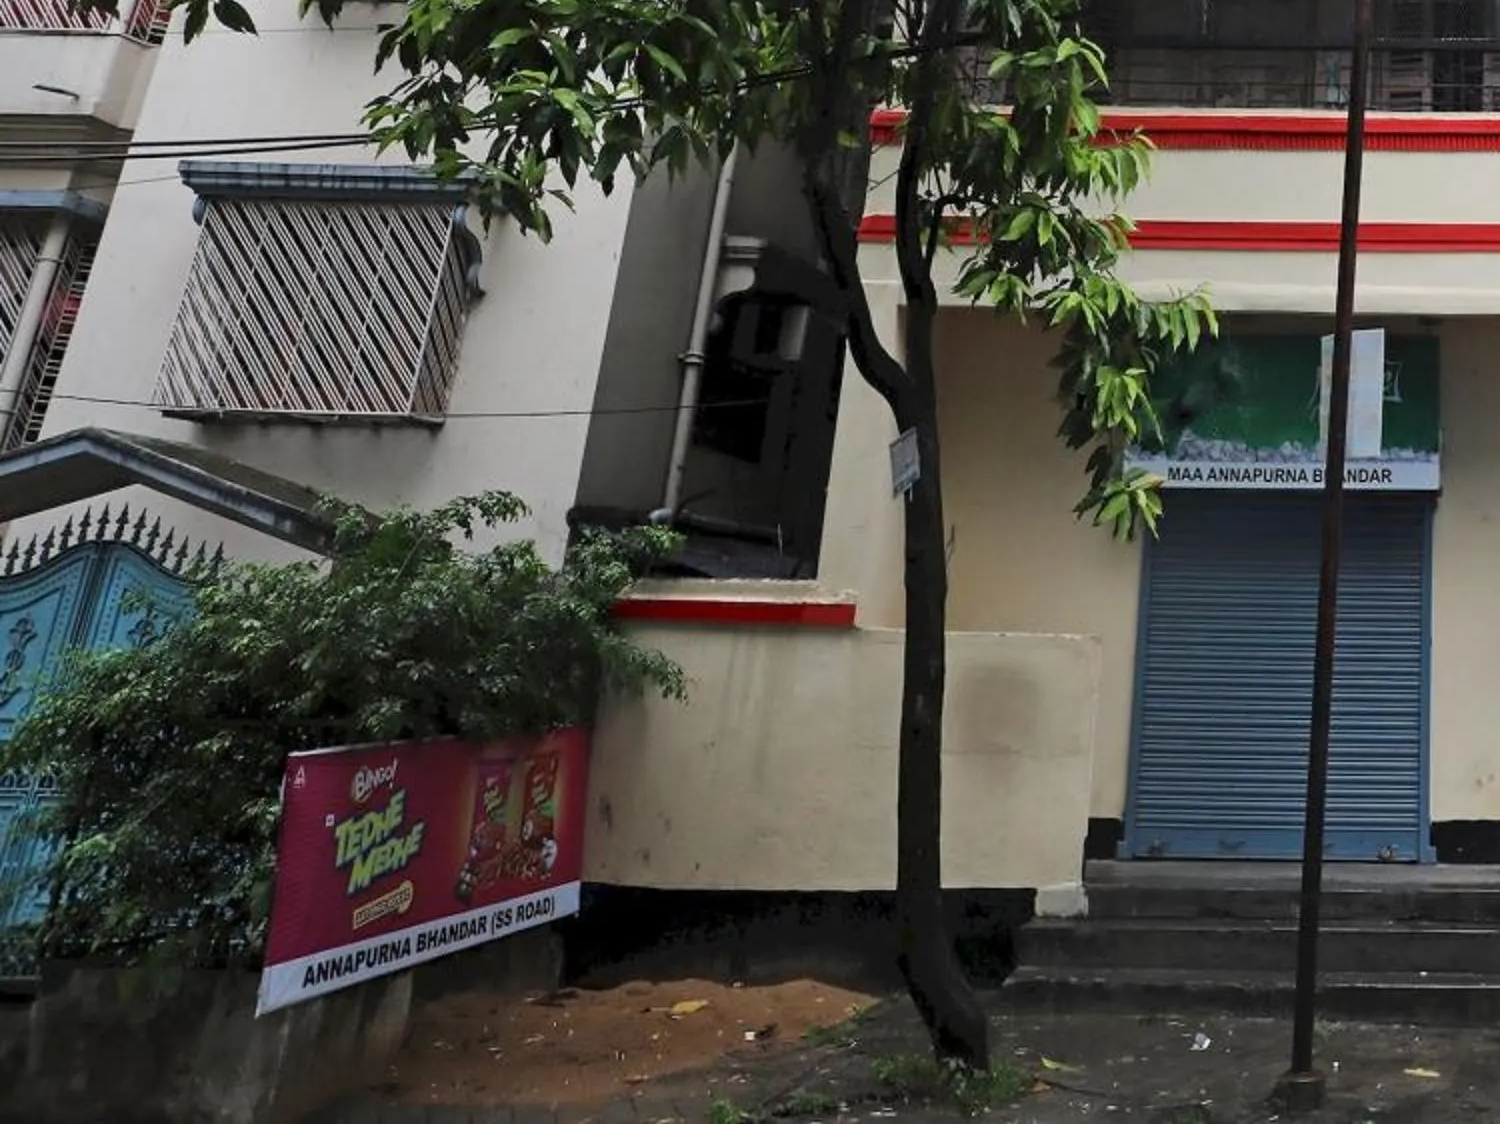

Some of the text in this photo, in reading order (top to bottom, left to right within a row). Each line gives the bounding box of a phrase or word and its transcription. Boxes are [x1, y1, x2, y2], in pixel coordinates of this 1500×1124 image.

[1167, 466, 1393, 485] MAA ANNAPURNA BNDAR
[302, 895, 557, 989] ANNAPURNA BHANDAR (SS ROAD)
